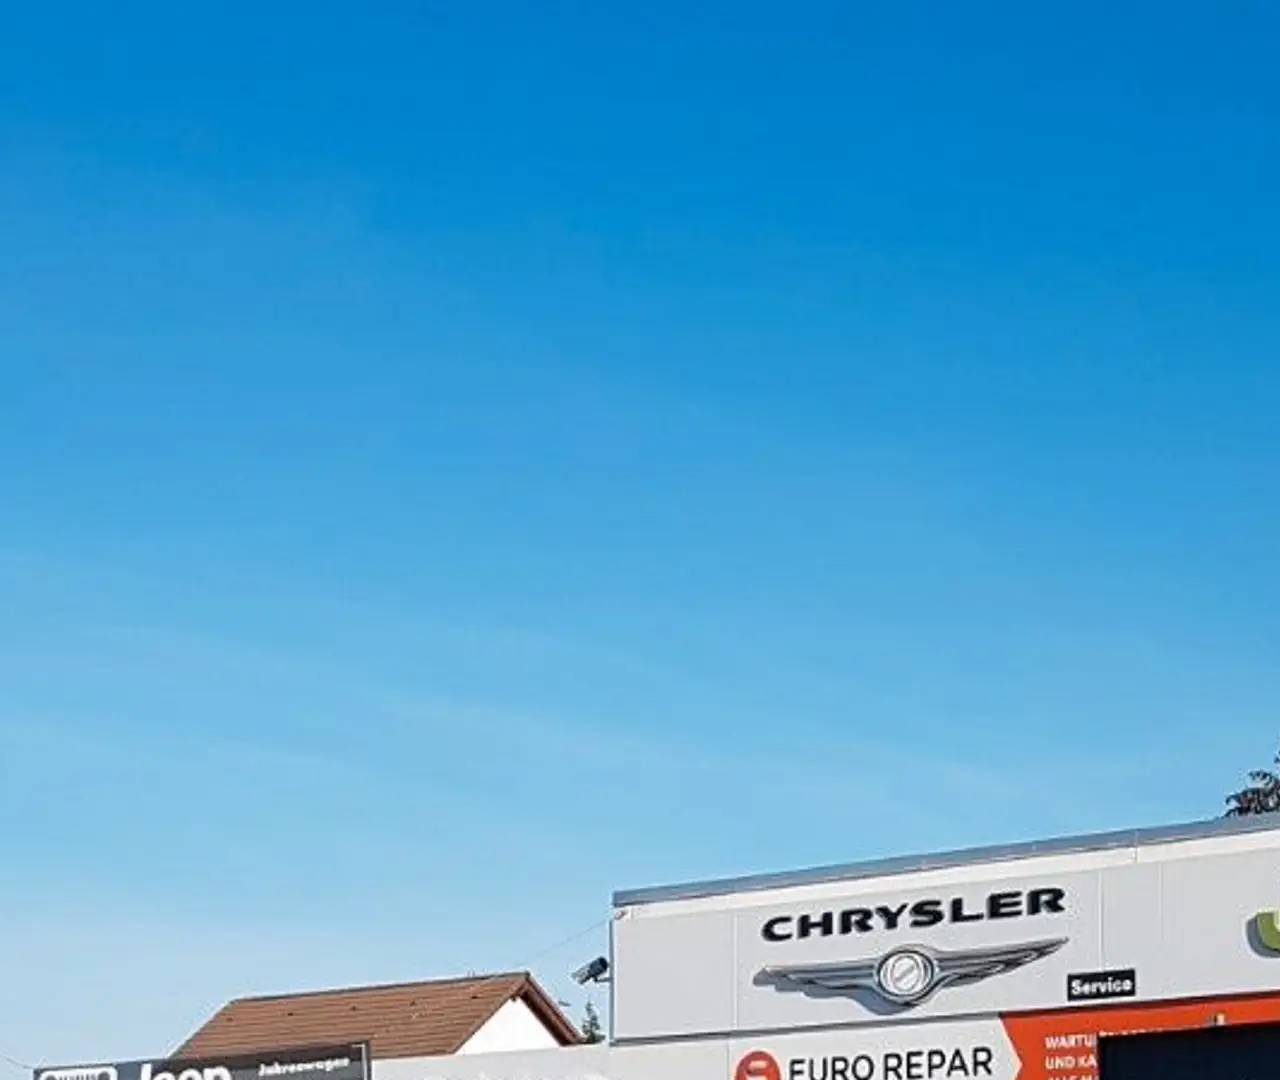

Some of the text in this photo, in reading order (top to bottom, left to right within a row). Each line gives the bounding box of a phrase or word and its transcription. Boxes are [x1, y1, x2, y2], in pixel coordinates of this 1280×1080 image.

[762, 888, 1066, 941] CHRYSLER
[1071, 977, 1133, 996] Service
[883, 1046, 993, 1080] REPAR
[1045, 1056, 1075, 1070] UND
